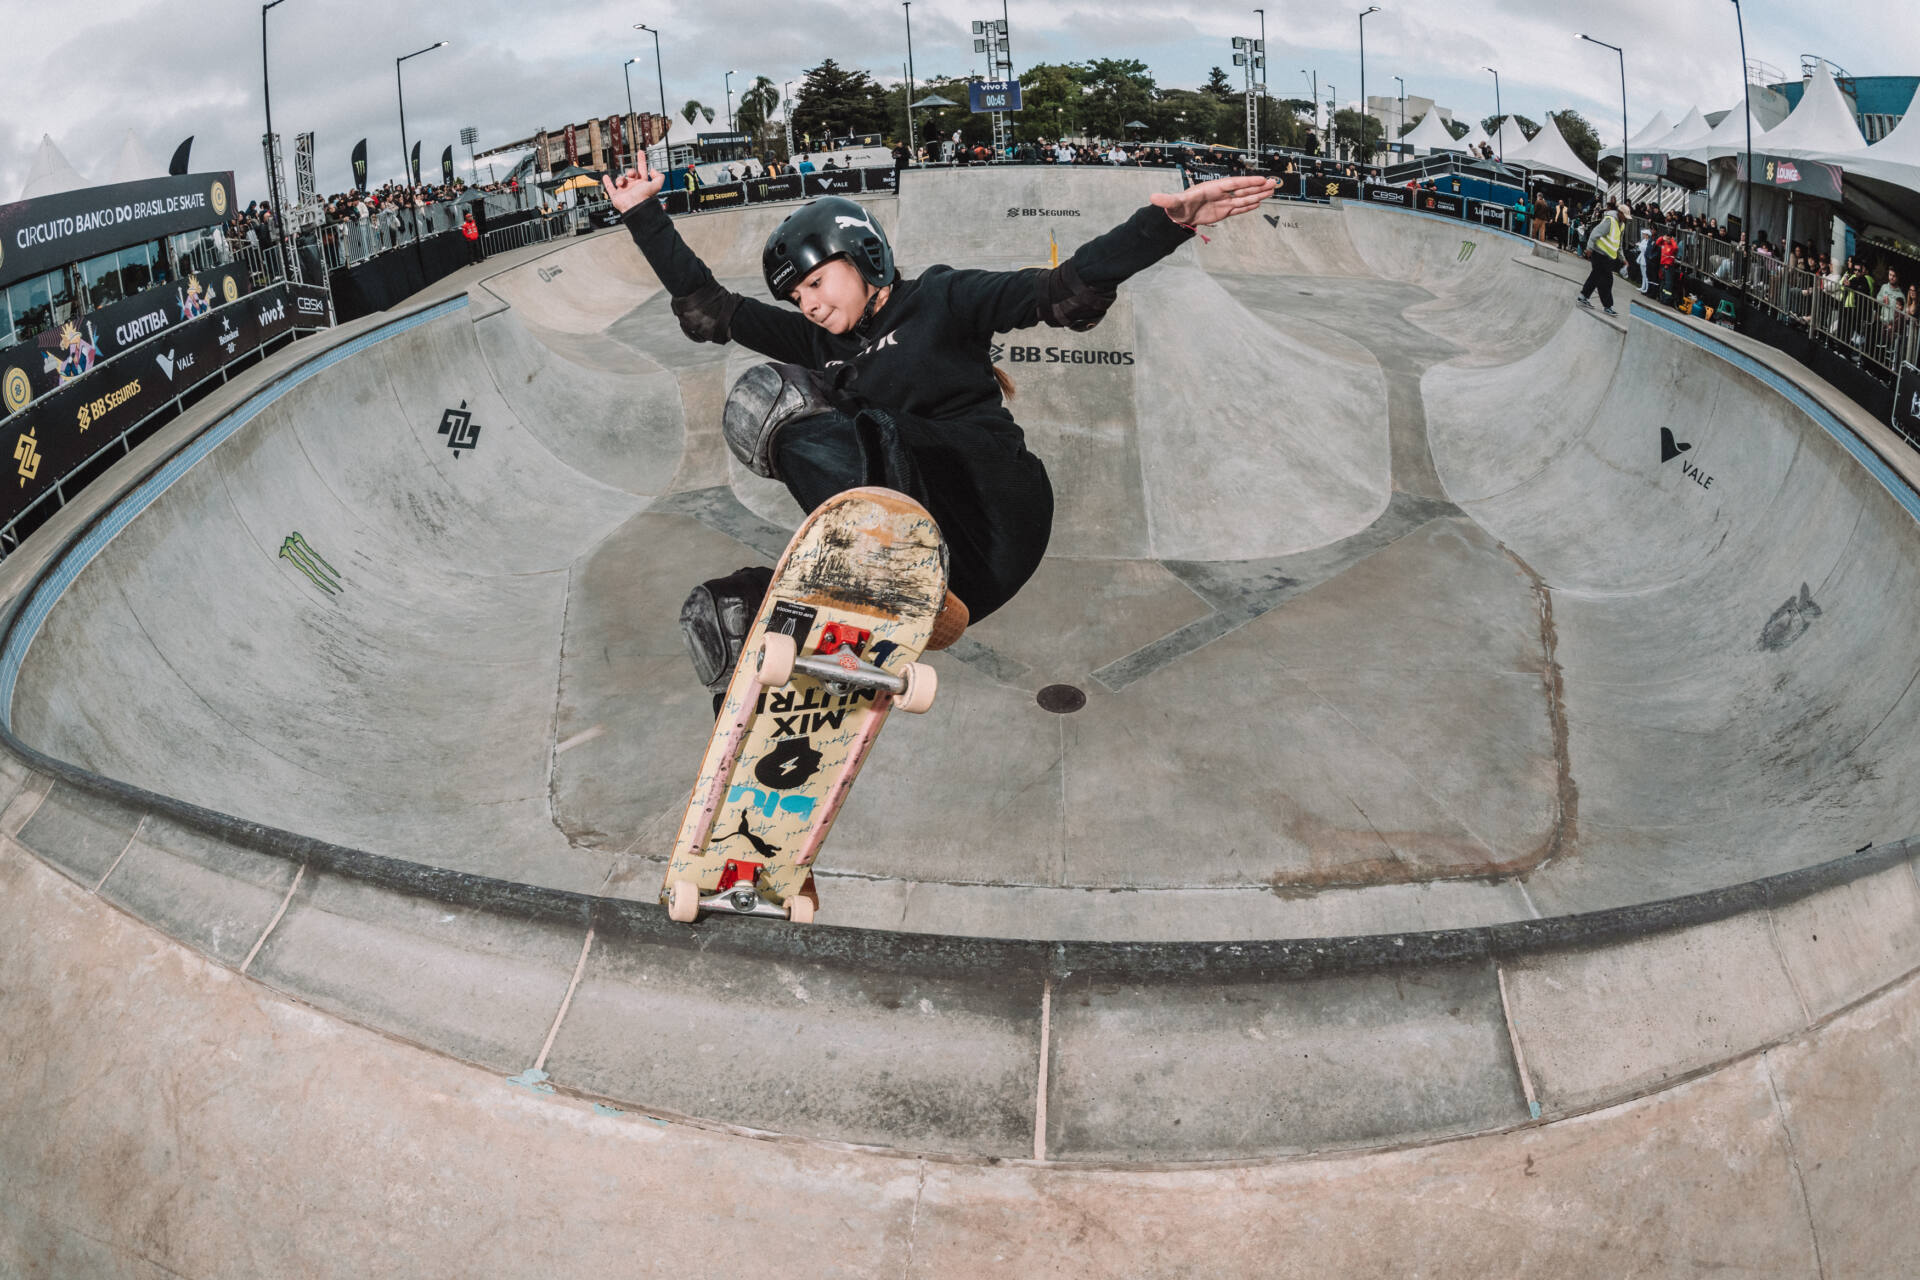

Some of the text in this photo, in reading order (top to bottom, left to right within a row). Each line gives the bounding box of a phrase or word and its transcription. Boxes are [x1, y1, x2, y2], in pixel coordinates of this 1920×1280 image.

[986, 94, 1005, 107] 00:45
[1777, 167, 1798, 181] LOUNGE
[17, 193, 205, 248] CIRCUITO BANCO DO BRASIL DE SKATE
[1022, 208, 1081, 217] BB SEGUROS
[116, 309, 169, 346] CURITIBA
[258, 306, 279, 327] vivo
[219, 327, 240, 346] Heineken
[176, 352, 195, 371] VALE
[1009, 346, 1135, 366] BB SEGUROS
[90, 379, 141, 421] BB SEGUROS
[1682, 459, 1714, 490] VALE
[756, 688, 876, 715] NUTRI
[770, 709, 845, 738] MIX
[727, 785, 818, 822] blu
